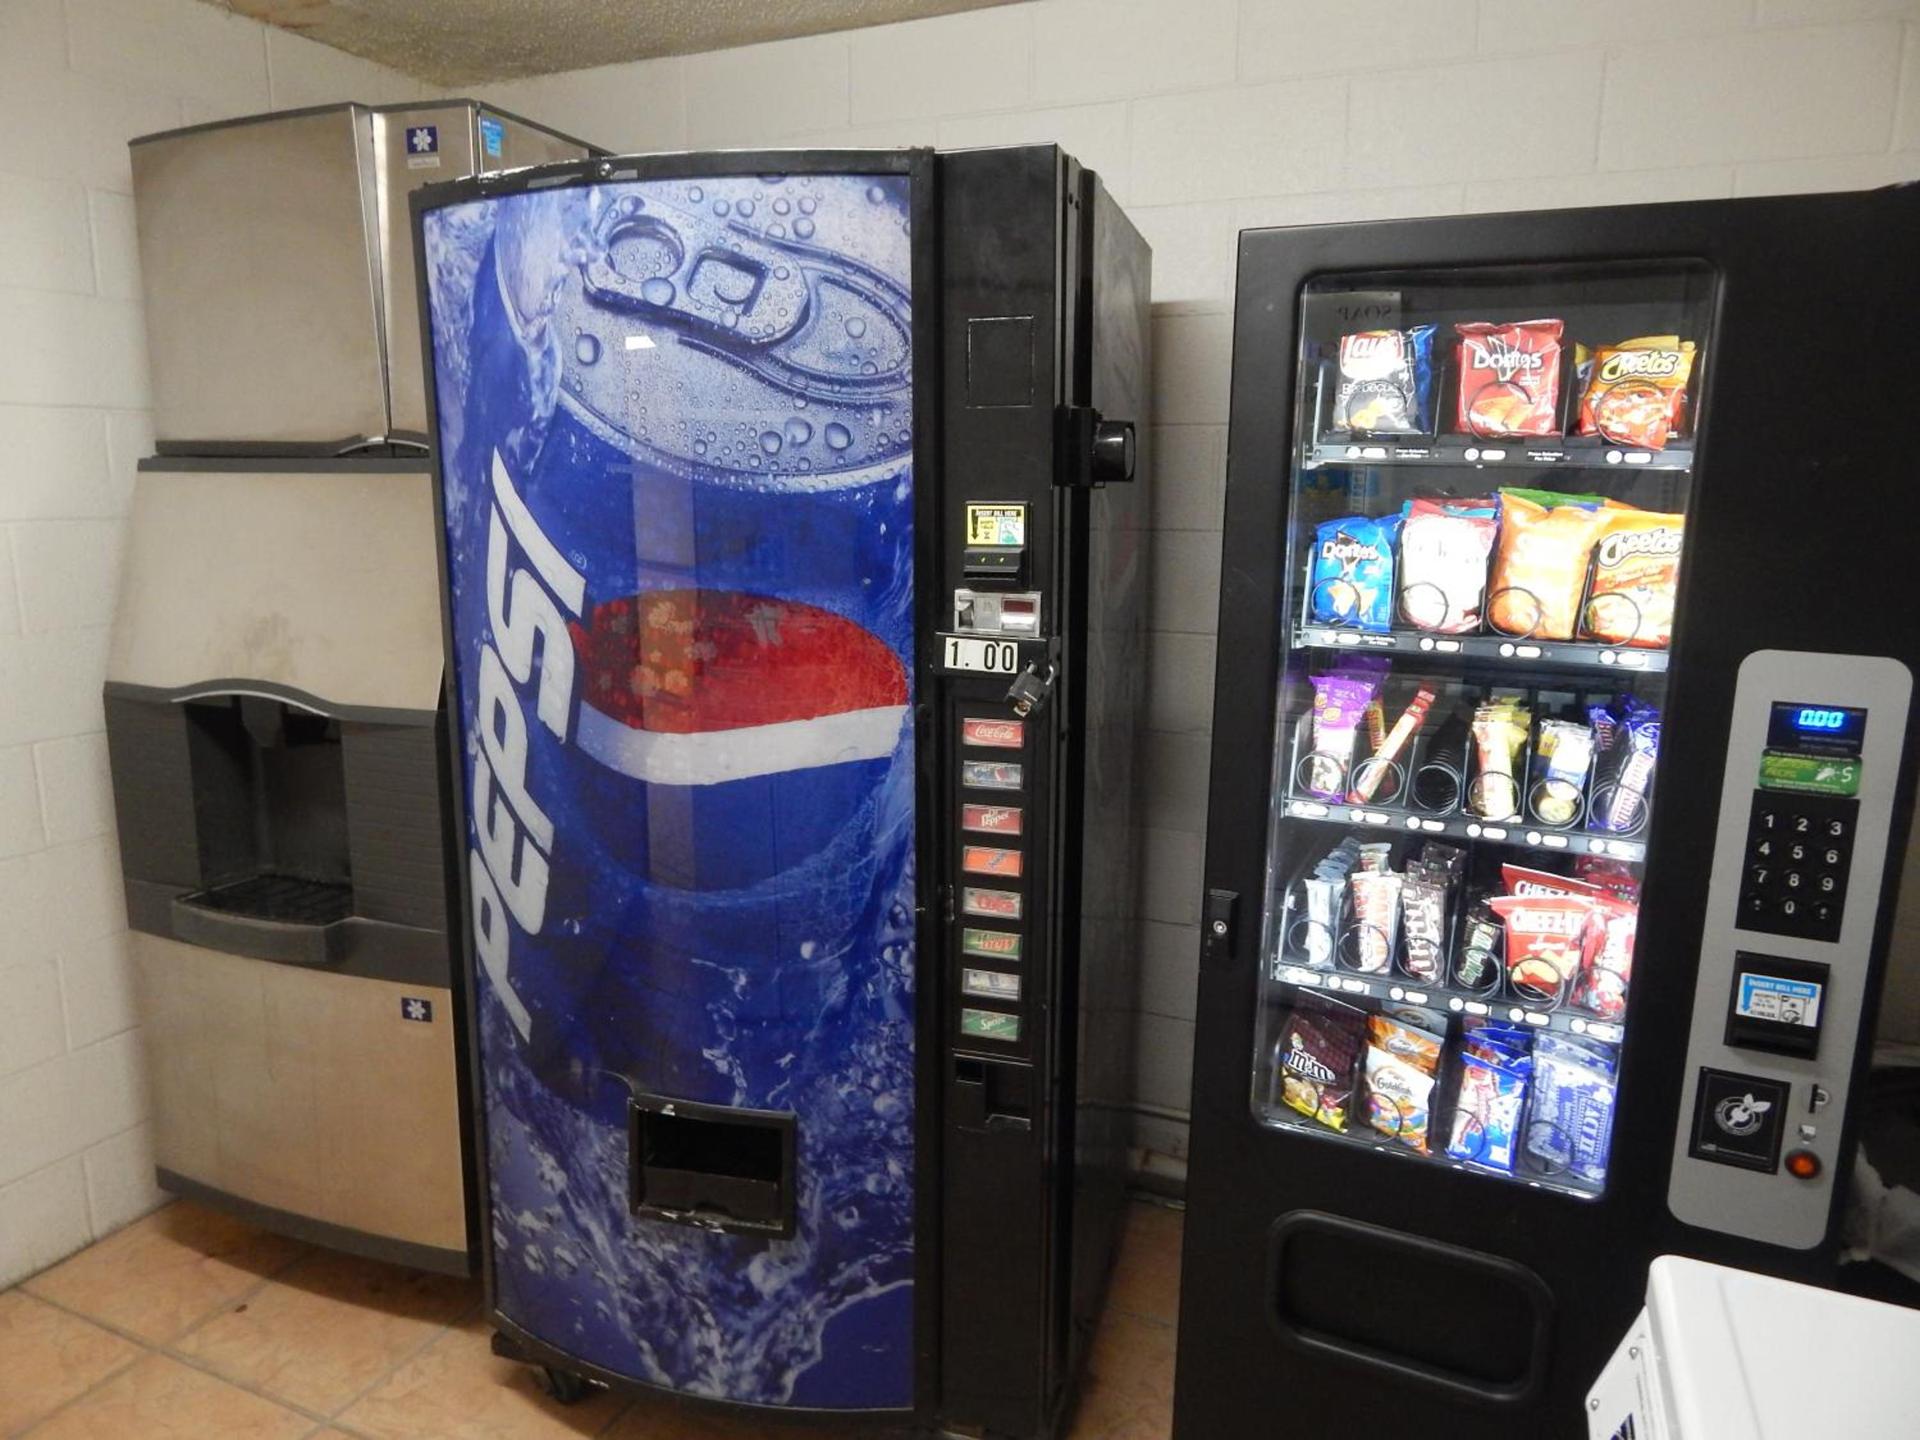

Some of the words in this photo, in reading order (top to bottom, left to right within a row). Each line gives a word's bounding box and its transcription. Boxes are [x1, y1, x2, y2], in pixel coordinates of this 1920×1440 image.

[1600, 350, 1679, 382] Cheetos
[471, 445, 586, 1044] PEPSI
[1764, 814, 1775, 828] 1
[1796, 818, 1808, 832] 2
[1829, 821, 1843, 836] 3
[1759, 842, 1771, 856] 4
[1792, 846, 1804, 860] 5
[1826, 849, 1838, 864] 6
[1757, 869, 1768, 883] 7
[1788, 873, 1800, 887] 8
[1822, 877, 1834, 891] 9
[1784, 901, 1795, 914] 0
